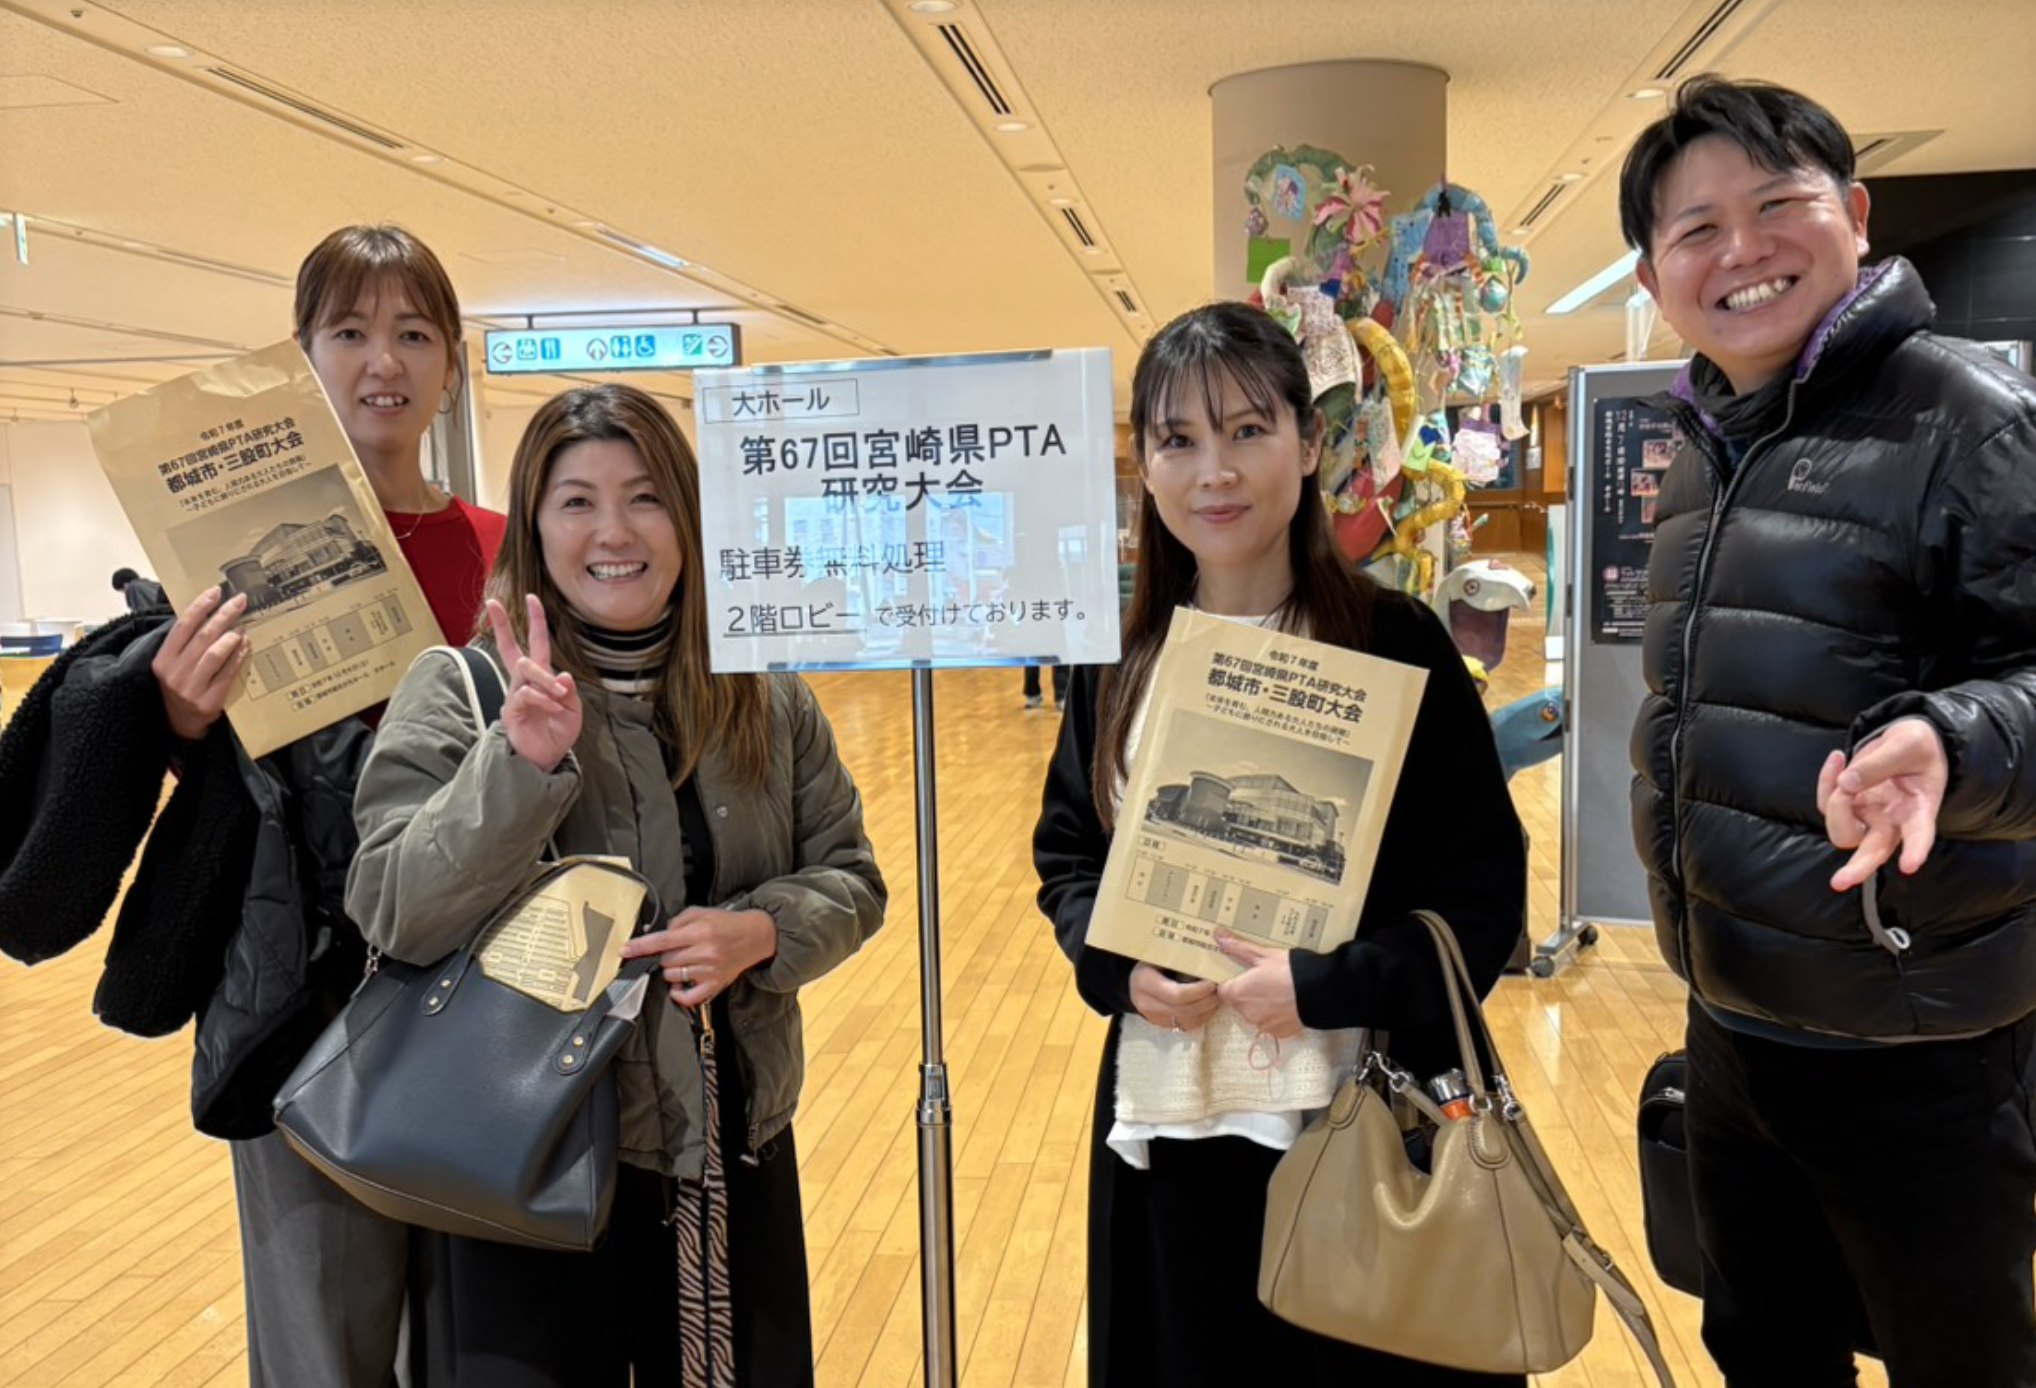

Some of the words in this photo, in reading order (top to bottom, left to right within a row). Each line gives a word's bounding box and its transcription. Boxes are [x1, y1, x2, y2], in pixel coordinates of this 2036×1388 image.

[732, 387, 830, 417] 大ホール
[158, 416, 296, 476] 第67回宮崎県PTA研究大会
[739, 423, 1067, 476] 第67回宮崎県PTA
[821, 468, 985, 512] 研究大会
[726, 602, 861, 634] 2階ロビー
[877, 598, 1086, 629] で受付けております。
[1207, 668, 1363, 724] 都城市・三股町大会
[1212, 652, 1367, 703] 第67回宮崎県PTA研究大会
